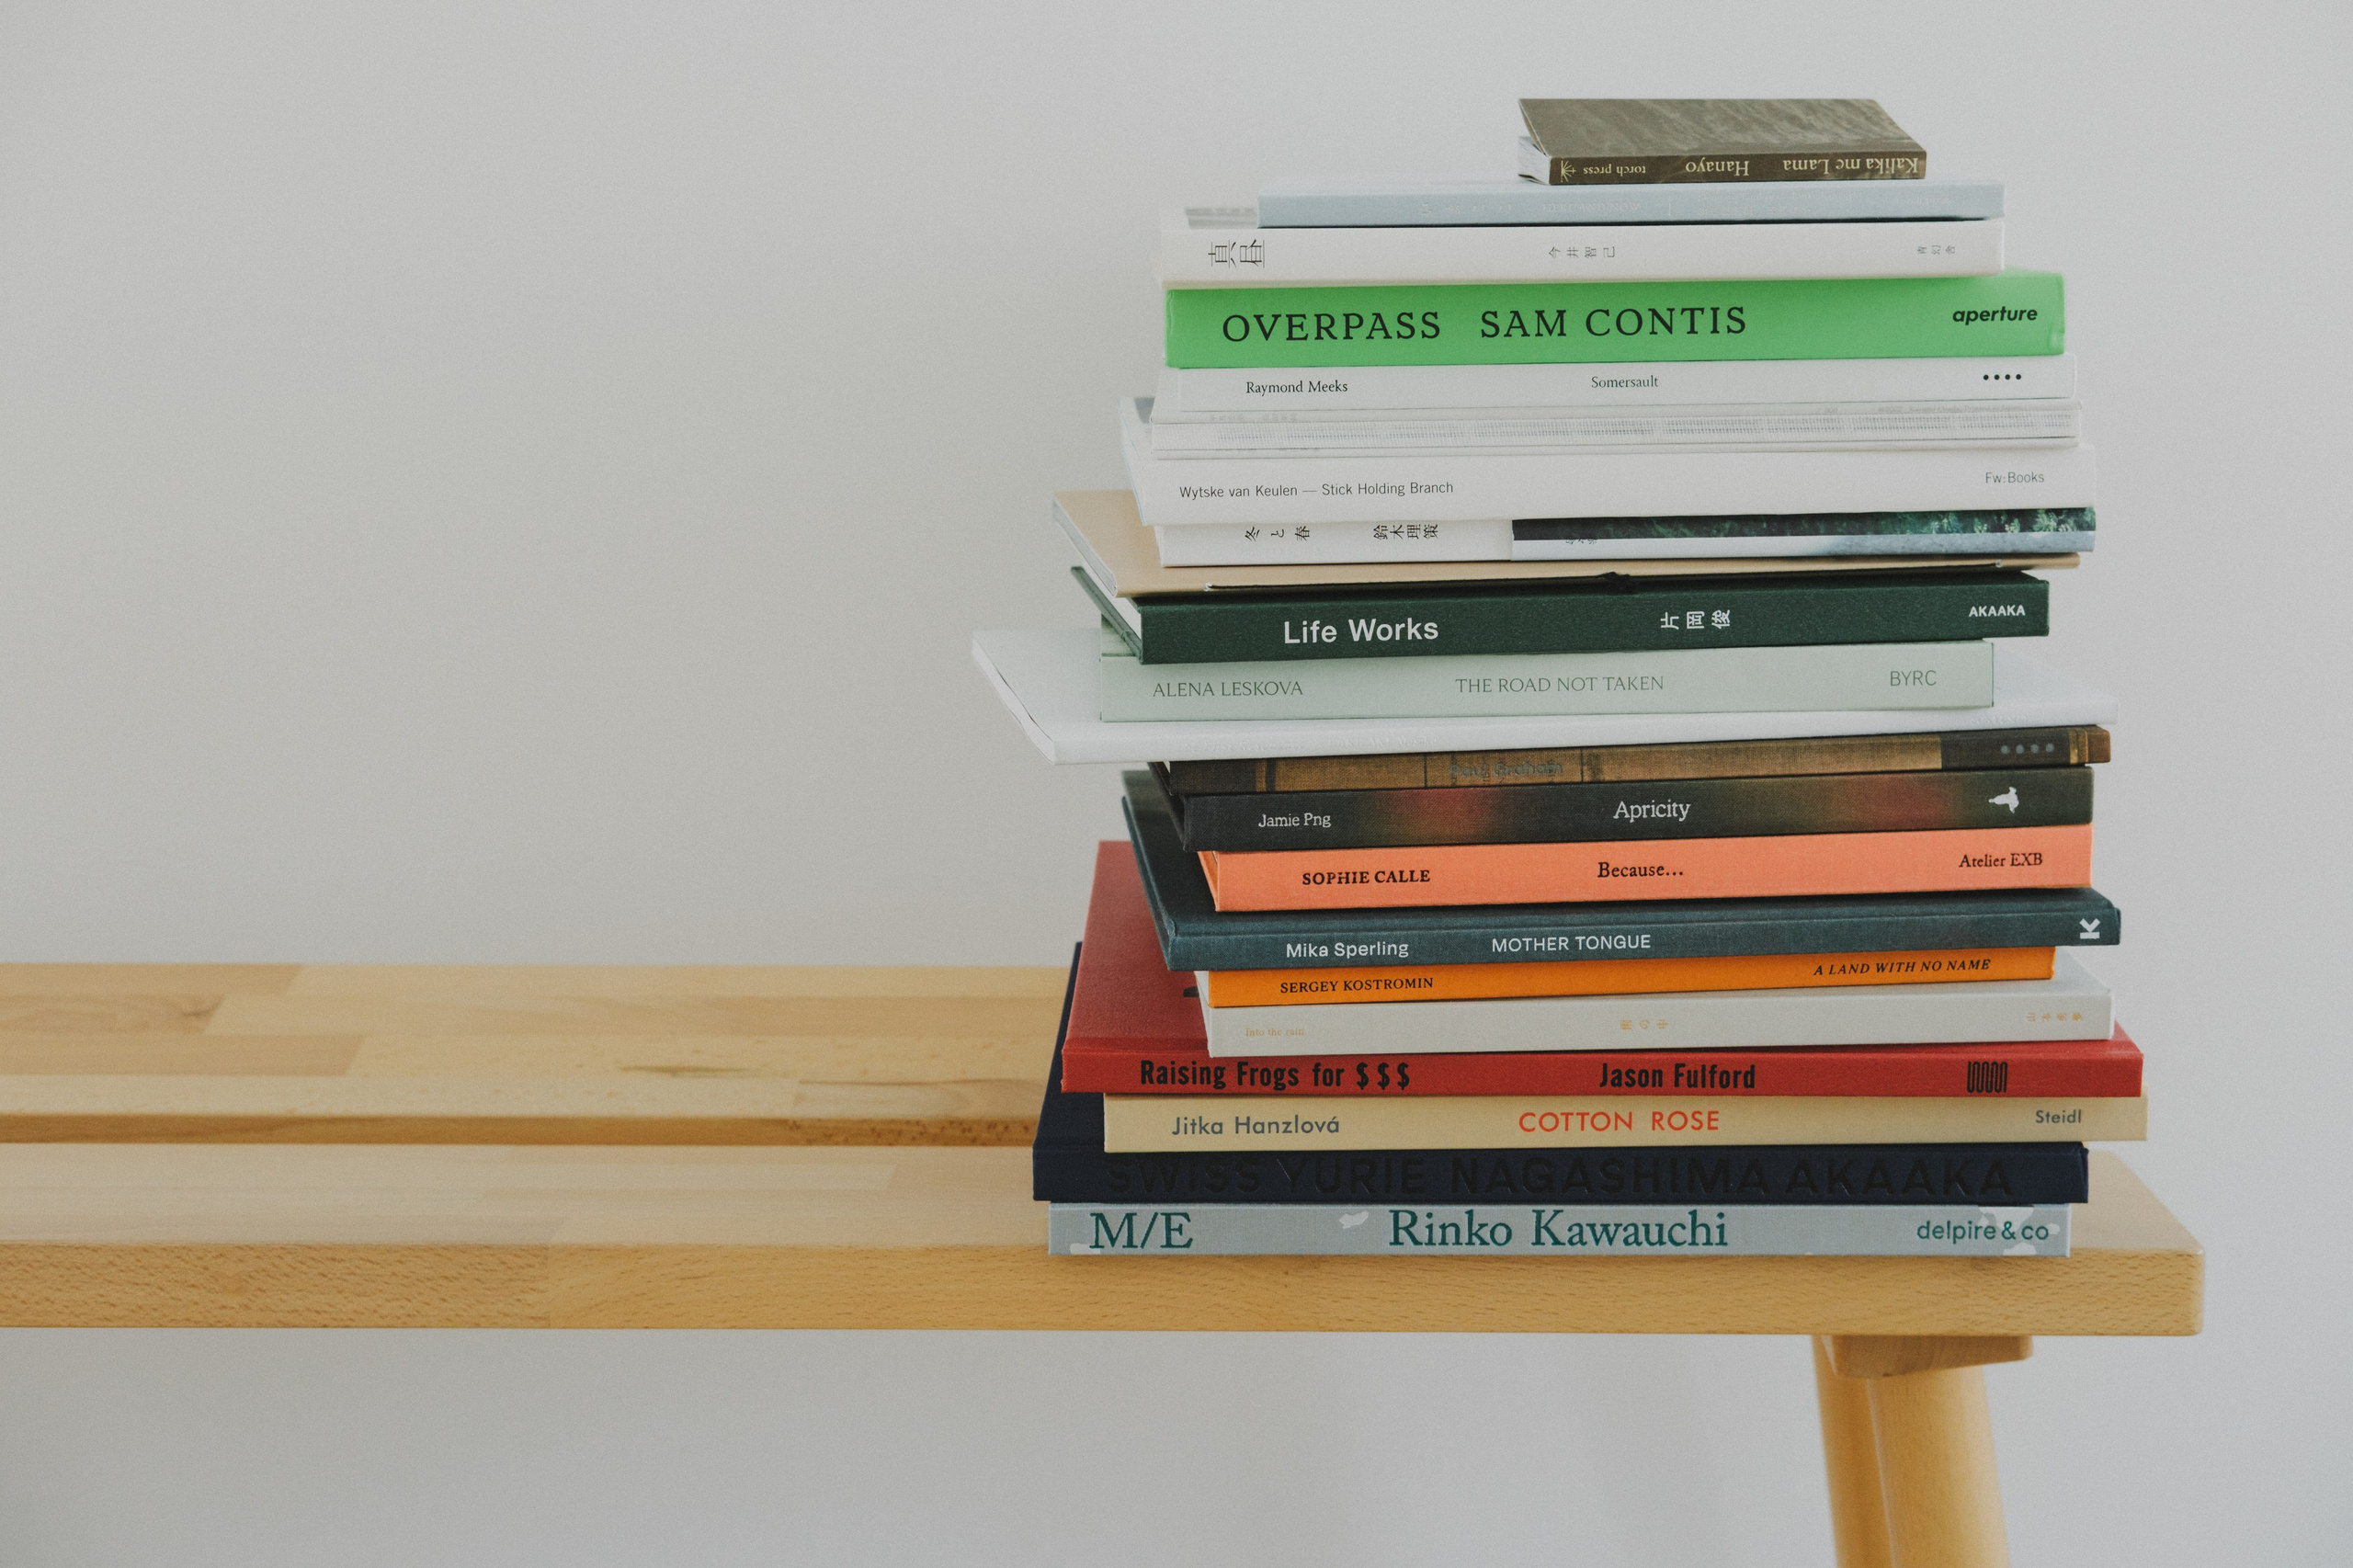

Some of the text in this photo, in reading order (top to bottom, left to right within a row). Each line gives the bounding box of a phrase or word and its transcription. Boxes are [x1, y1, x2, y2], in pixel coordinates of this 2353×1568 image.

[1583, 164, 1646, 176] torch press
[1685, 157, 1749, 176] Hanayo
[1783, 159, 1829, 174] Lama
[1866, 157, 1918, 174] Kalika
[1208, 239, 1265, 268] 真昼
[1549, 246, 1615, 259] 今井智己
[1952, 305, 2039, 325] aperture
[1222, 305, 1746, 343] OVERPASS SAM CONTIS
[1245, 380, 1348, 396] Raymond Meeks
[1591, 375, 1658, 388] Somersault
[1985, 472, 2045, 483] Fw:Books
[1179, 486, 1224, 500] Wytske
[1229, 488, 1250, 497] van
[1256, 485, 1298, 496] Keulen
[1322, 483, 1353, 495] Stick
[1358, 483, 1405, 497] Holding
[1410, 482, 1453, 494] Branch
[1373, 524, 1438, 540] 鈴木理策
[1969, 605, 2026, 617] AKAAKA
[1660, 609, 1731, 631] 片岡俊
[1284, 618, 1439, 643] Life Works
[1455, 676, 1665, 693] THE ROAD NOT TAKEN
[1890, 670, 1937, 687] BYRC
[1153, 681, 1303, 697] ALENA LESKOVA
[1450, 760, 1563, 778] Paul Graham
[1258, 812, 1332, 828] Jamie Png
[1613, 799, 1691, 824] Apricity
[1959, 852, 2043, 868] Atelier EXB
[1302, 869, 1431, 885] SOPHIE CALLE
[1286, 941, 1409, 960] Mika Sperling
[1492, 934, 1652, 952] MOTHER TONGUE
[1813, 959, 1992, 975] A LAND WITH NO NAME
[1280, 977, 1434, 994] SERGEY KOSTROMIN
[1245, 1028, 1265, 1037] Into
[1268, 1028, 1282, 1037] the
[1141, 1060, 1226, 1089] Raising
[1237, 1062, 1300, 1091] Frogs
[1312, 1062, 1345, 1086] for
[1599, 1062, 1756, 1089] Jason Fulford
[1172, 1114, 1339, 1135] Jitka Hanzlová
[1518, 1110, 1720, 1132] COTTON ROSE
[2035, 1108, 2082, 1124] Steidl
[1106, 1156, 2015, 1196] SWISS YURIE NAGASHIMA AKAAKA
[1089, 1209, 1729, 1250] M/E Rinko Kawauchi
[1916, 1220, 1996, 1244] delpire
